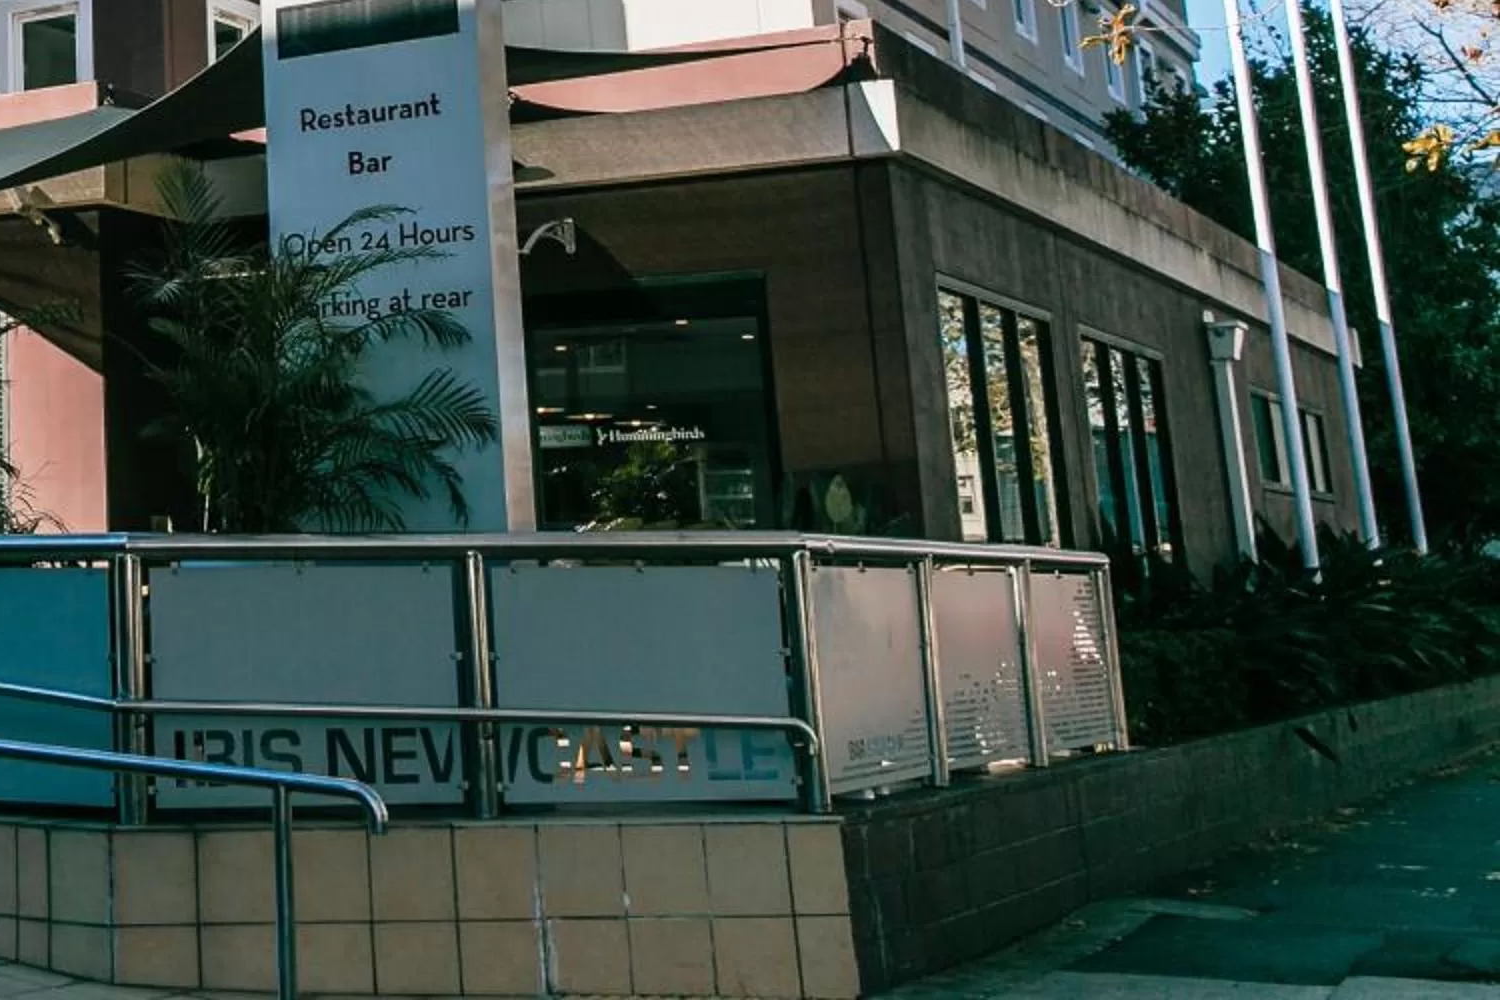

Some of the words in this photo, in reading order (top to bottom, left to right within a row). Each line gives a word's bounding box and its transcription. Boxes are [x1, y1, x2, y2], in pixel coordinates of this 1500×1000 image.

[300, 92, 442, 132] Restaurant
[348, 151, 393, 175] Bar
[284, 232, 352, 262] Open
[360, 230, 390, 252] 24
[400, 221, 475, 247] Hours
[300, 290, 381, 321] arking
[389, 288, 411, 311] at
[420, 288, 473, 310] rear
[174, 728, 303, 788] IBIS
